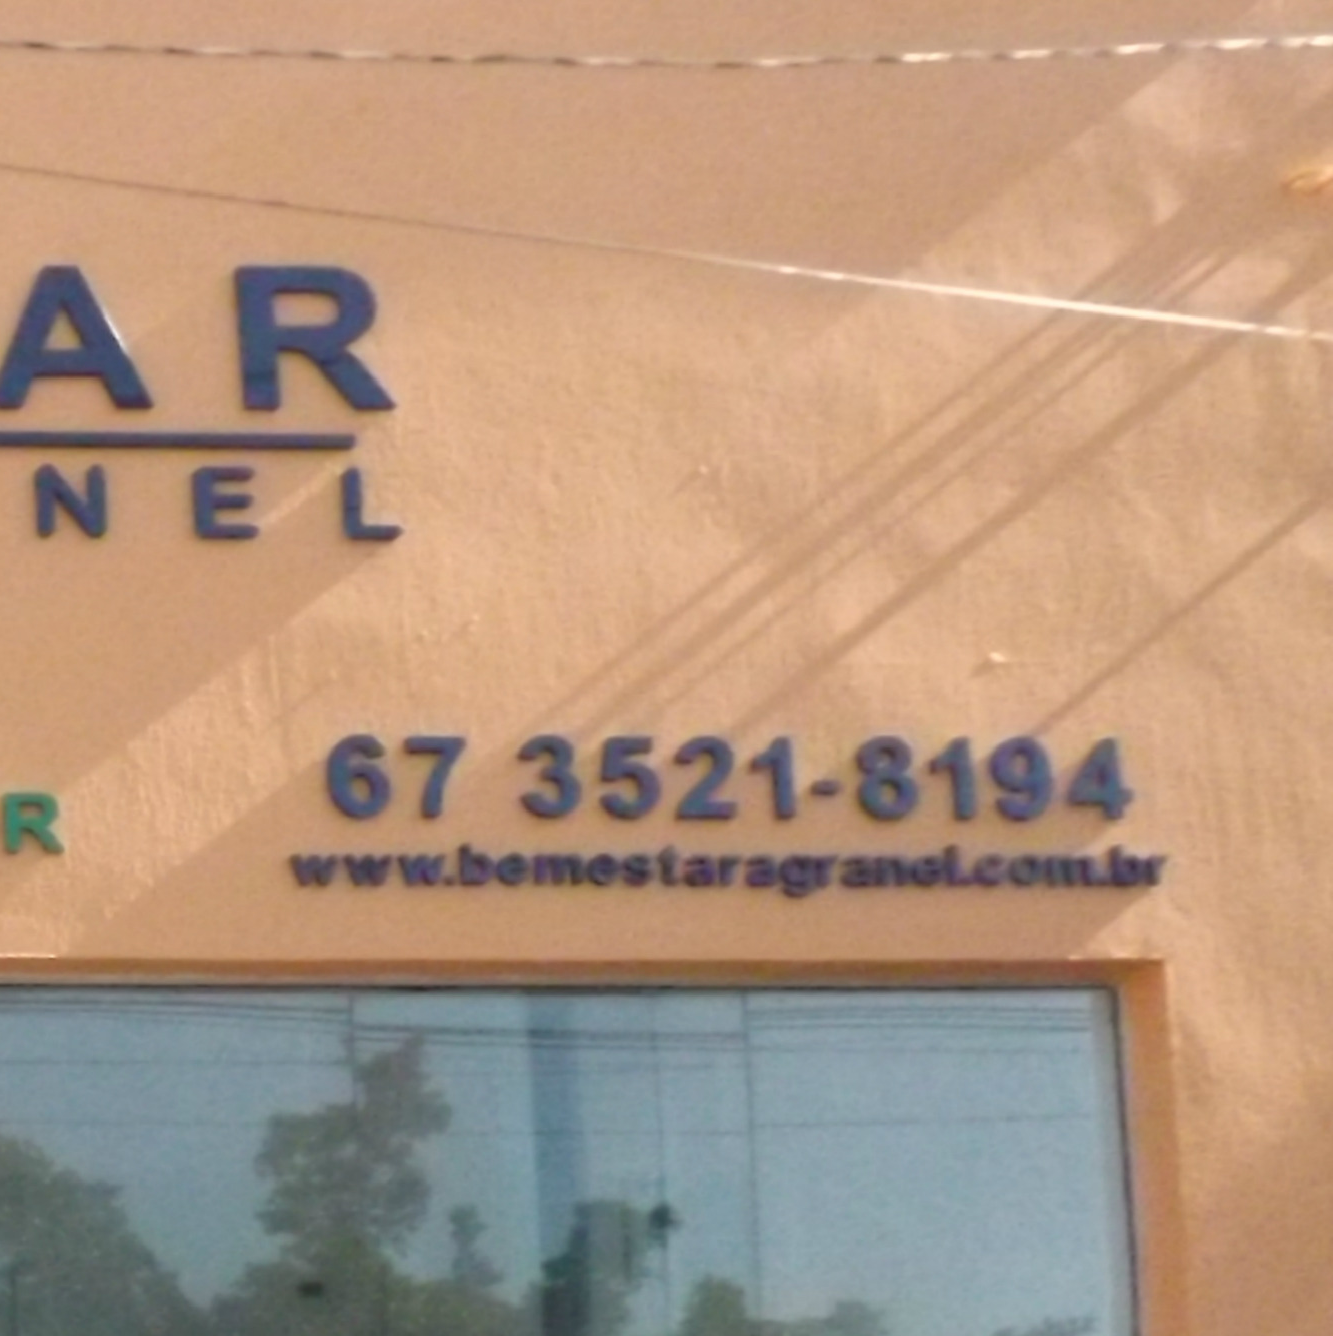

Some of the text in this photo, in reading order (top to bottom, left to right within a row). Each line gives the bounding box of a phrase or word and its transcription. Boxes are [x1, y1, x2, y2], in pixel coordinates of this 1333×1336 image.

[324, 734, 1135, 822] 67 3521-8194
[288, 844, 1170, 898] www.bemestaragranel.com.br
